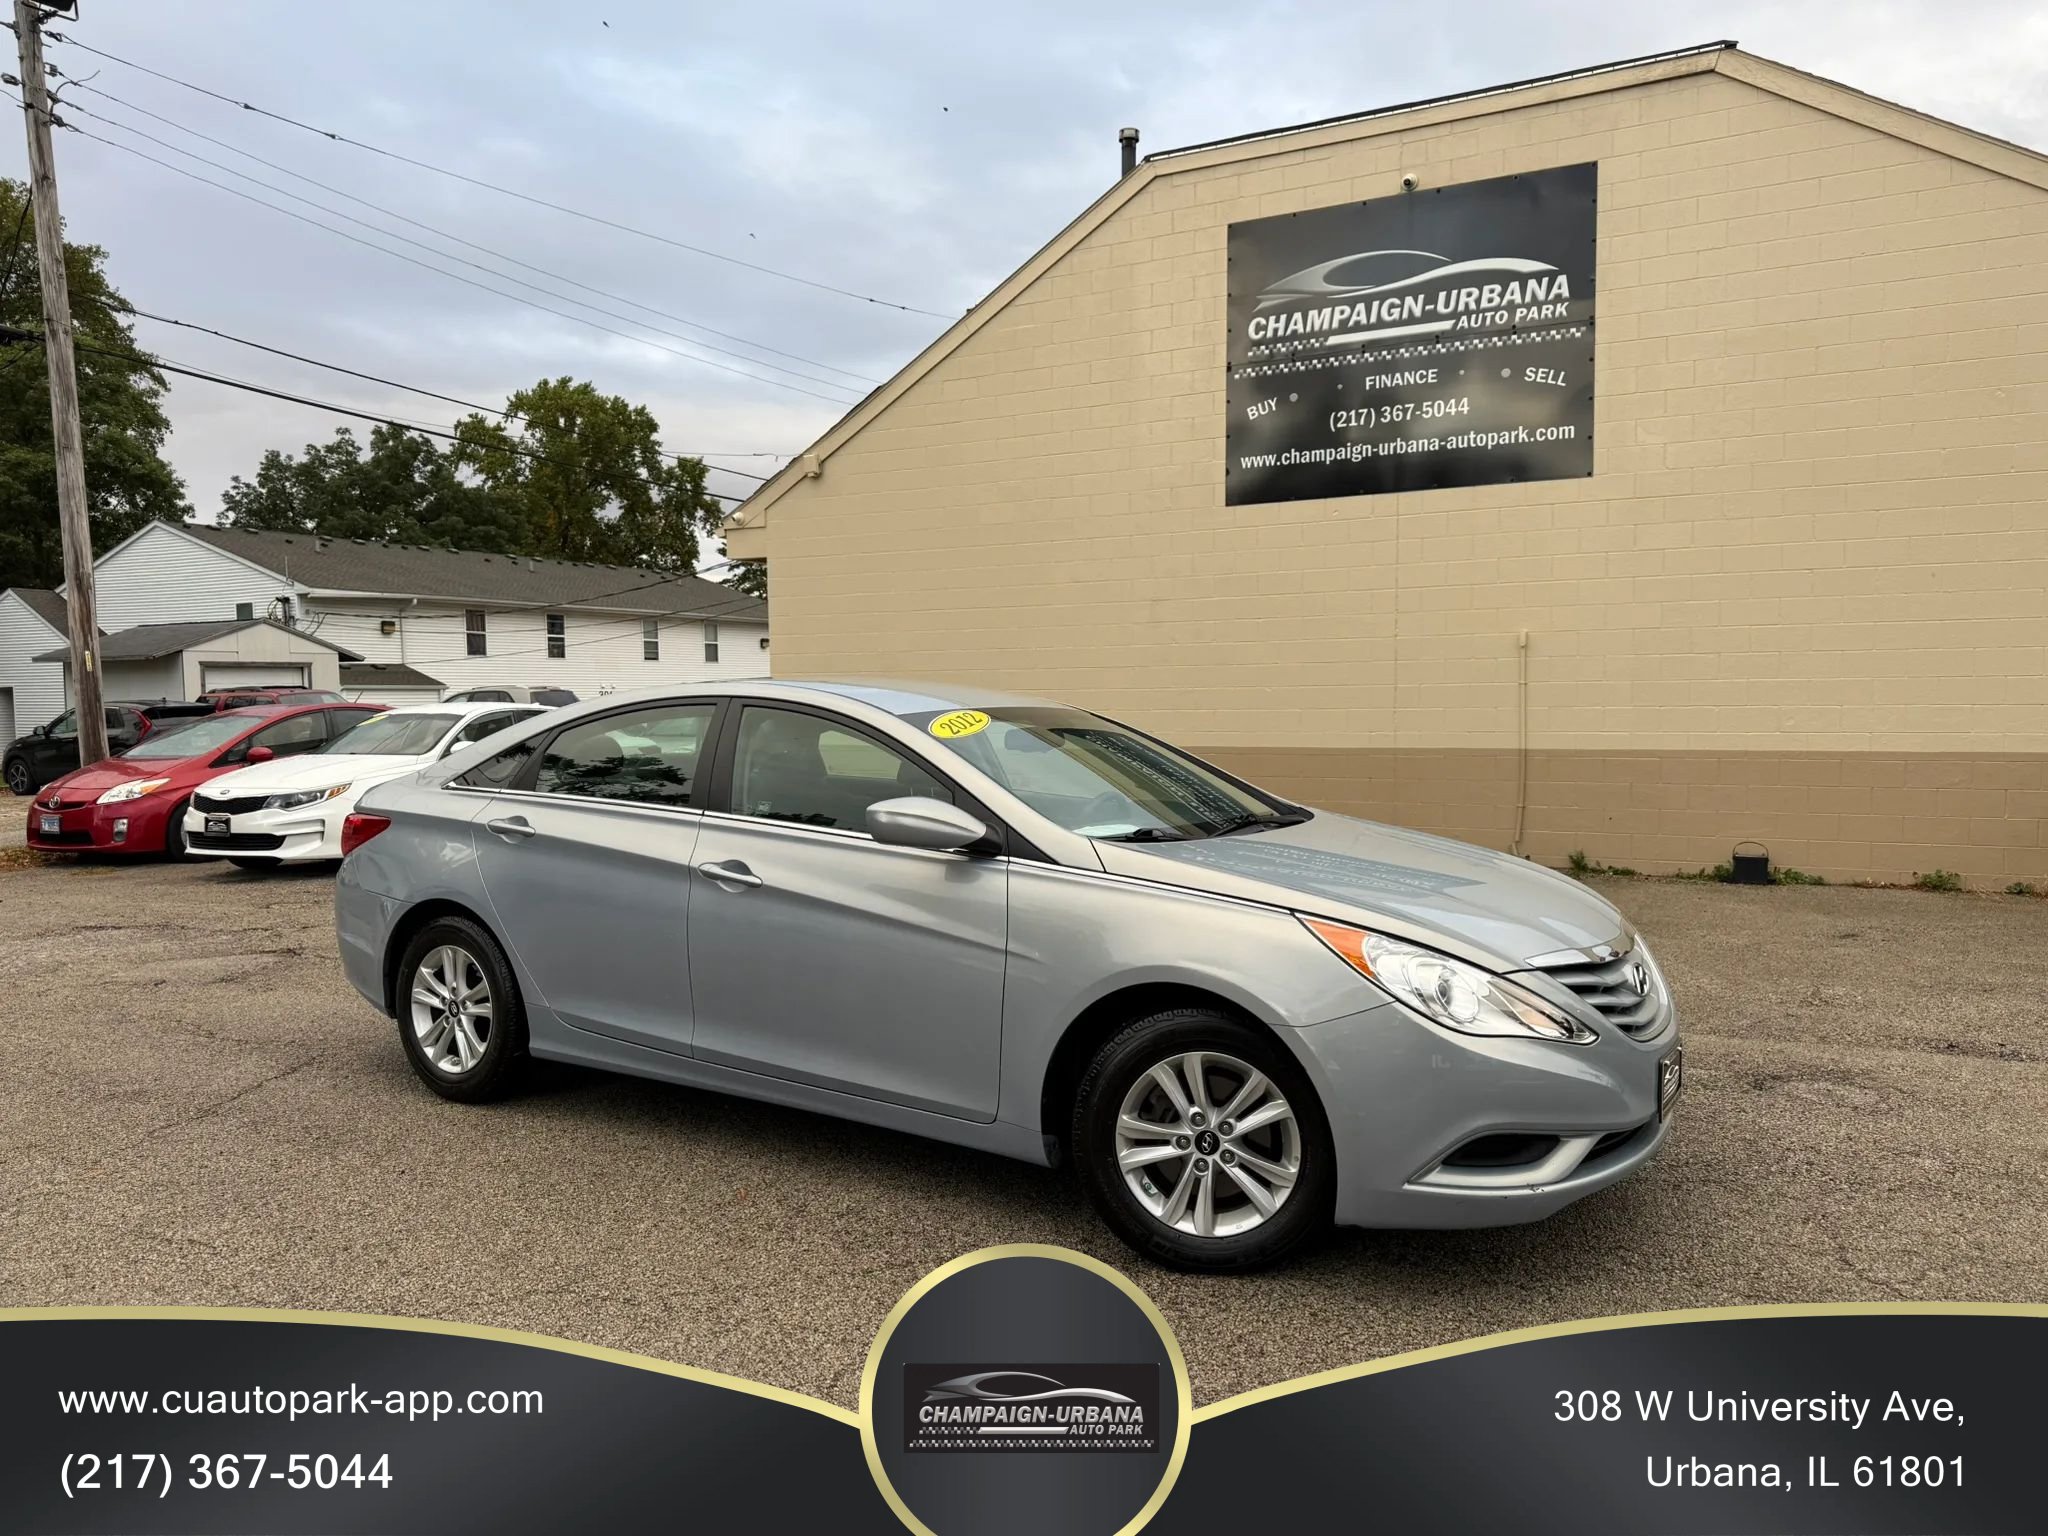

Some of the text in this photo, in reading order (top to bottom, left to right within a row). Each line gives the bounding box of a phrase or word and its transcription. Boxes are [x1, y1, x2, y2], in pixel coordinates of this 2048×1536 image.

[1247, 274, 1570, 341] CHAMPAIGN-URBANA
[1456, 301, 1570, 332] AUTO PARK
[1364, 368, 1439, 391] FINANCE
[1523, 366, 1567, 387] SELL
[1246, 397, 1278, 421] BUY
[1329, 396, 1471, 432] (217) 367-5044
[1240, 423, 1576, 470] www.champaign-urbana-autopark.com
[940, 712, 983, 735] 2012
